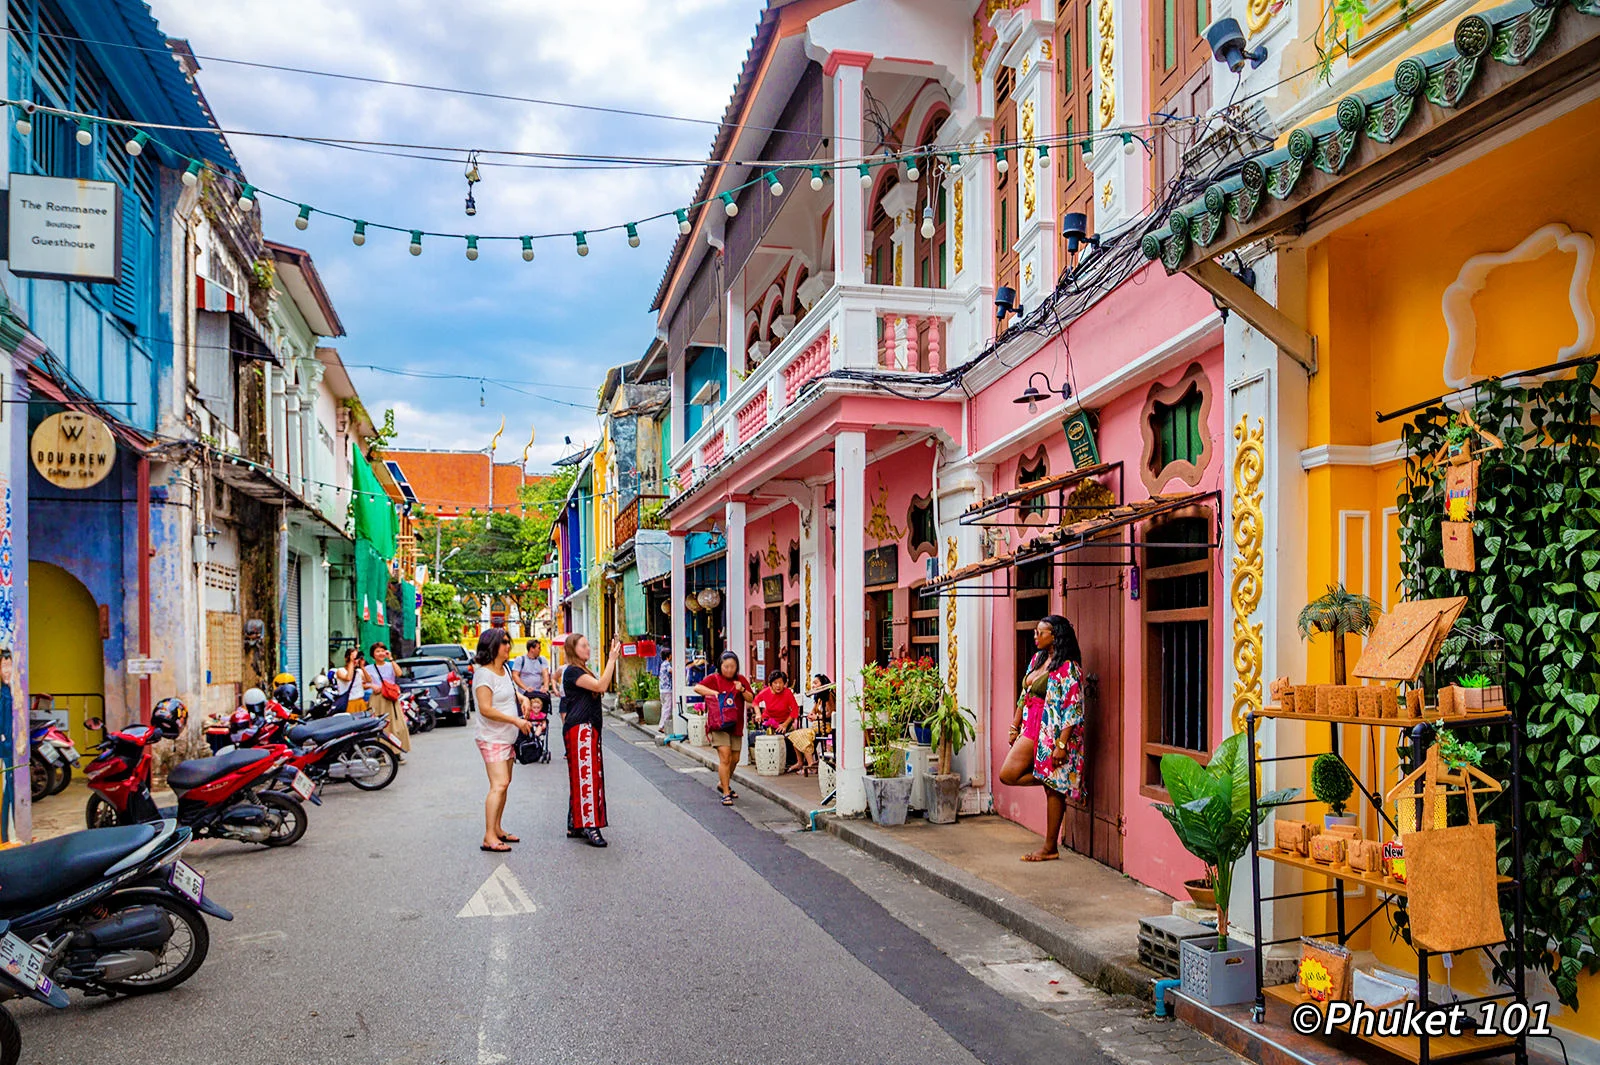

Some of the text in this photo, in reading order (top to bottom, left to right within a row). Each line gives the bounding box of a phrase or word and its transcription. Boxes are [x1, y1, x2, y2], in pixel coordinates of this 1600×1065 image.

[20, 199, 108, 216] The Rommanee
[45, 220, 82, 230] Boutique
[31, 235, 96, 250] Guesthouse
[70, 452, 106, 467] BREW
[1384, 844, 1404, 858] New
[24, 953, 41, 982] 1157
